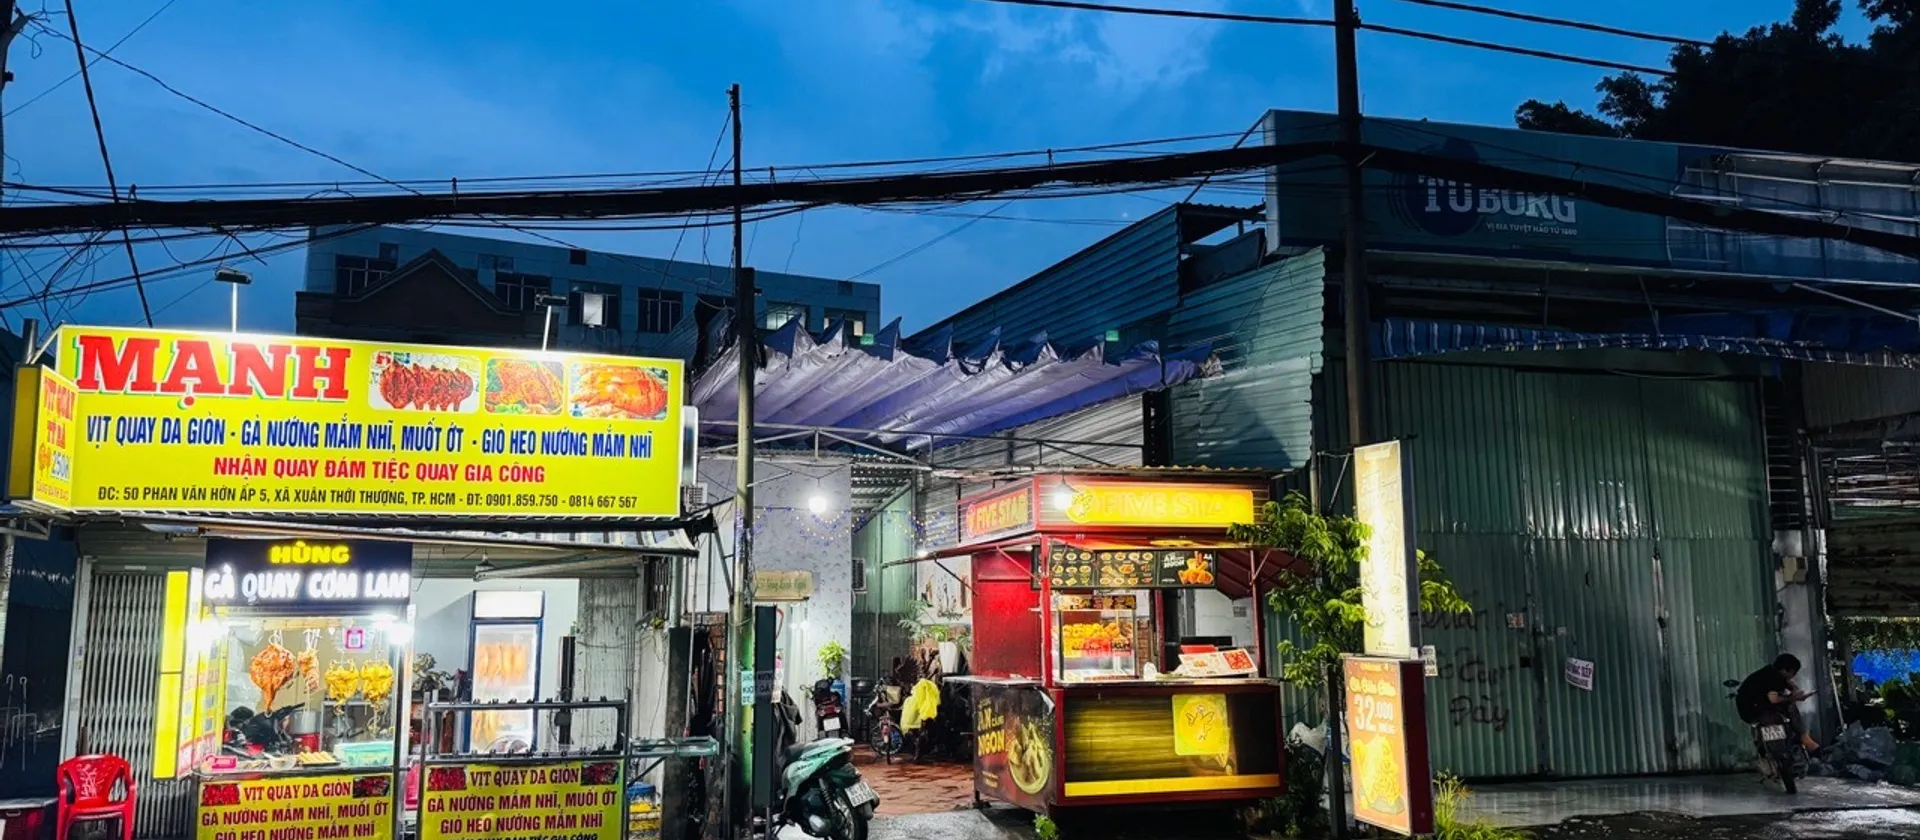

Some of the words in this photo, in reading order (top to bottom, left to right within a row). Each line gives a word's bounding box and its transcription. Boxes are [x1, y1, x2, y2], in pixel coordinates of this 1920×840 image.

[75, 334, 351, 407] MẠNH
[87, 415, 111, 450] VỊT
[116, 416, 156, 445] QUAY
[161, 417, 181, 444] DA
[188, 412, 225, 445] GIÒN
[241, 416, 261, 446] GÀ
[267, 415, 319, 448] NƯỚNG
[324, 412, 361, 450] MẮM
[367, 420, 396, 454] NHĨ,
[447, 422, 463, 452] ỚT
[482, 423, 505, 454] GIÒ
[510, 429, 536, 455] HEO
[541, 427, 586, 457] NƯỚNG
[592, 424, 625, 458] MẮM
[630, 430, 653, 459] NHĨ
[214, 457, 266, 480] NHẬN
[273, 458, 319, 479] QUAY
[325, 458, 365, 479] ĐÁM
[373, 459, 409, 483] TIỆC
[416, 463, 457, 483] QUAY
[465, 464, 492, 483] GIA
[499, 461, 545, 483] CÔNG
[98, 486, 119, 501] ĐC:
[123, 486, 139, 500] 50
[143, 486, 177, 501] PHAN
[181, 484, 206, 502] VĂN
[240, 482, 256, 502] ẤP
[259, 488, 270, 504] 5,
[274, 486, 290, 503] XÃ
[294, 486, 326, 504] XUÂN
[360, 489, 408, 507] THƯỢNG,
[412, 491, 427, 506] TP.
[429, 491, 456, 506] HCM
[466, 492, 483, 507] ĐT:
[486, 493, 558, 508] 0901.859.750
[569, 495, 594, 508] 0814
[597, 495, 617, 508] 667
[619, 496, 638, 509] 567
[1103, 492, 1167, 518] FIVE
[976, 504, 998, 534] FIVE
[270, 541, 349, 564] HÙNG
[204, 564, 235, 598] GÀ
[242, 572, 300, 602] QUAY
[308, 571, 358, 598] CƠM
[365, 571, 408, 598] LAM
[978, 729, 1005, 757] NGON
[471, 771, 491, 790] VỊT
[494, 769, 528, 787] QUAY
[530, 768, 546, 784] DA
[549, 764, 580, 784] GIÒN
[244, 787, 264, 804] VỊT
[267, 785, 300, 802] QUAY
[303, 783, 320, 798] DA
[322, 778, 351, 797] GIÒN
[428, 795, 444, 812] GÀ
[450, 793, 494, 811] NƯỚNG
[499, 789, 531, 809] MẮM
[566, 787, 597, 807] MUỐI
[602, 790, 617, 806] ỚT
[202, 811, 218, 826] GÀ
[223, 807, 267, 824] NƯỚNG
[272, 803, 304, 822] MẮM
[338, 800, 370, 818] MUỐI
[374, 801, 389, 816] ỚT
[441, 815, 462, 834] GIÒ
[466, 818, 491, 832] HEO
[496, 813, 540, 831] NƯỚNG
[545, 809, 576, 829] MẮM
[270, 825, 313, 840] NƯỚNG
[318, 819, 349, 838] MẮM
